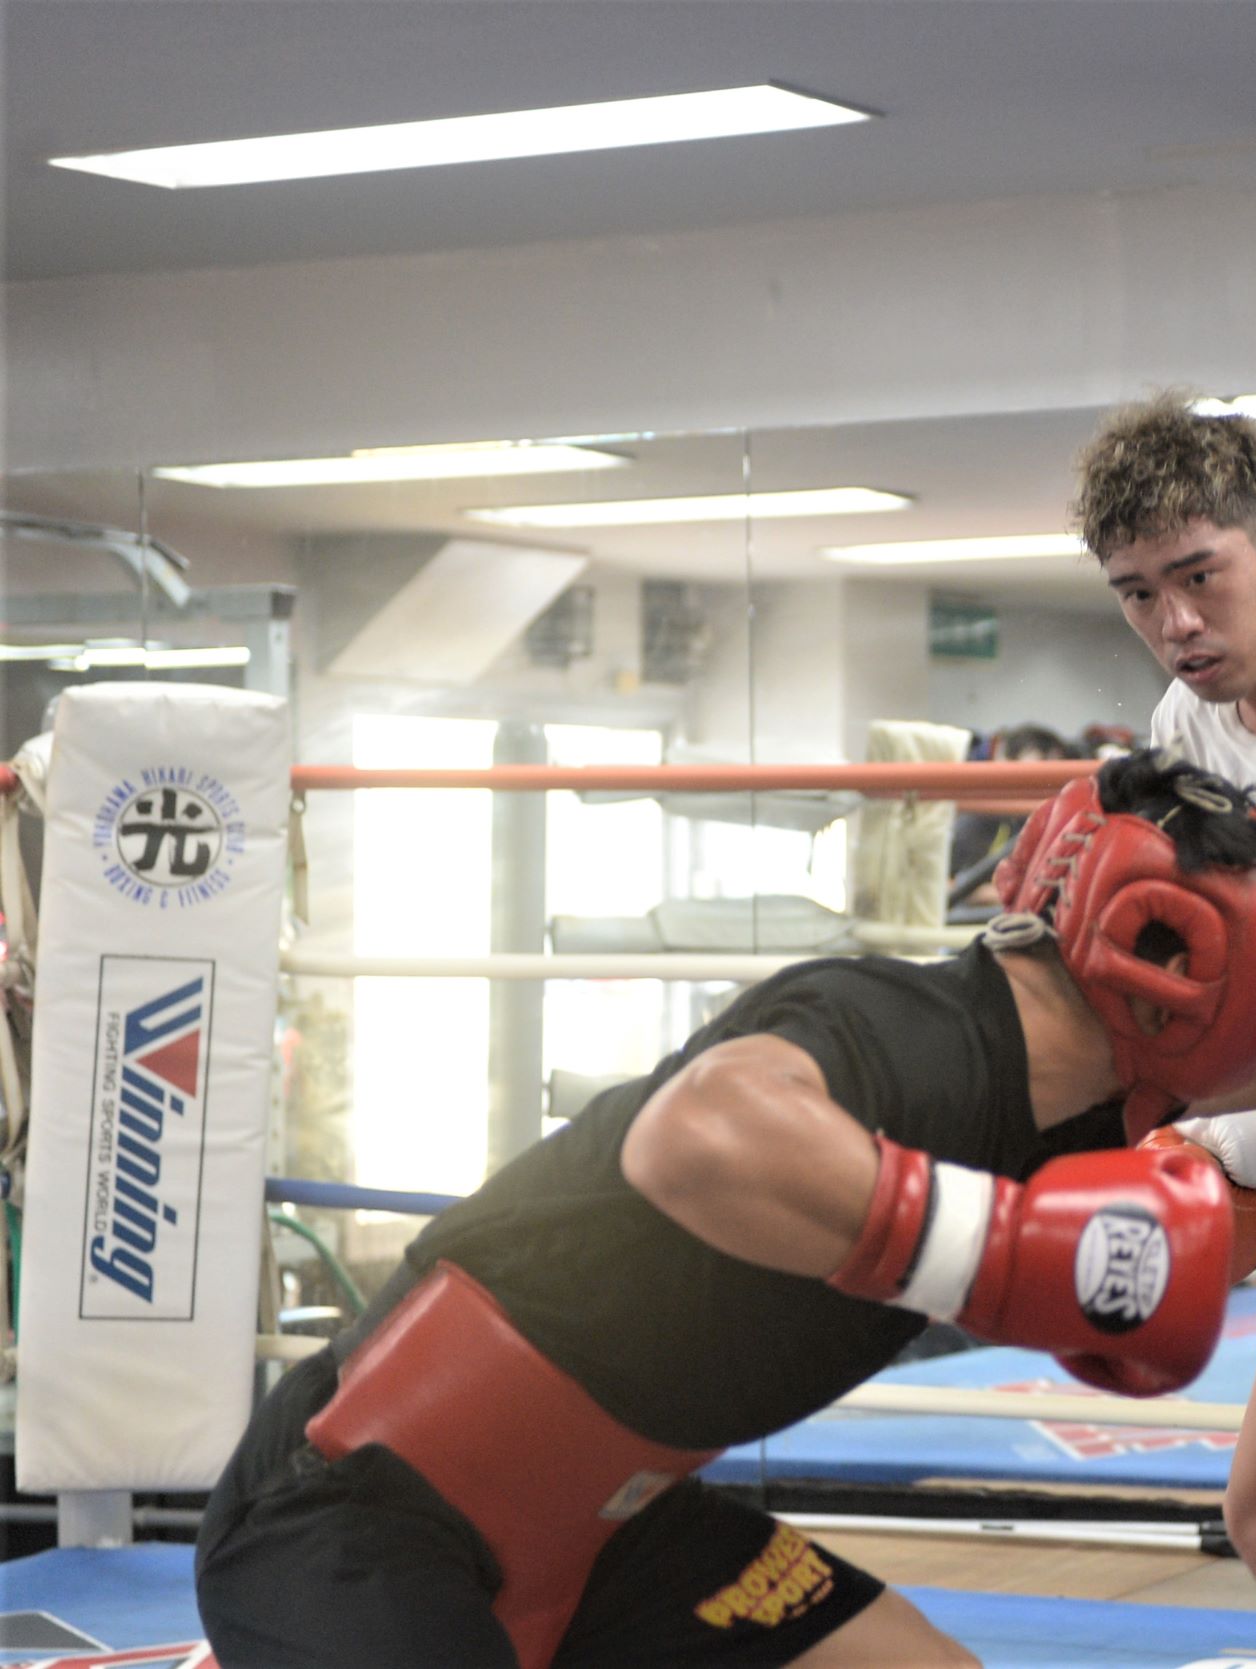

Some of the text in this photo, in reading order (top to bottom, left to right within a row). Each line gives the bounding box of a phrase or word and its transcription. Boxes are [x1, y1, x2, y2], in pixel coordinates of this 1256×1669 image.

[120, 788, 217, 877] 光
[90, 976, 203, 1304] Winning
[94, 1012, 120, 1232] FIGHTING SPORTS WORLD
